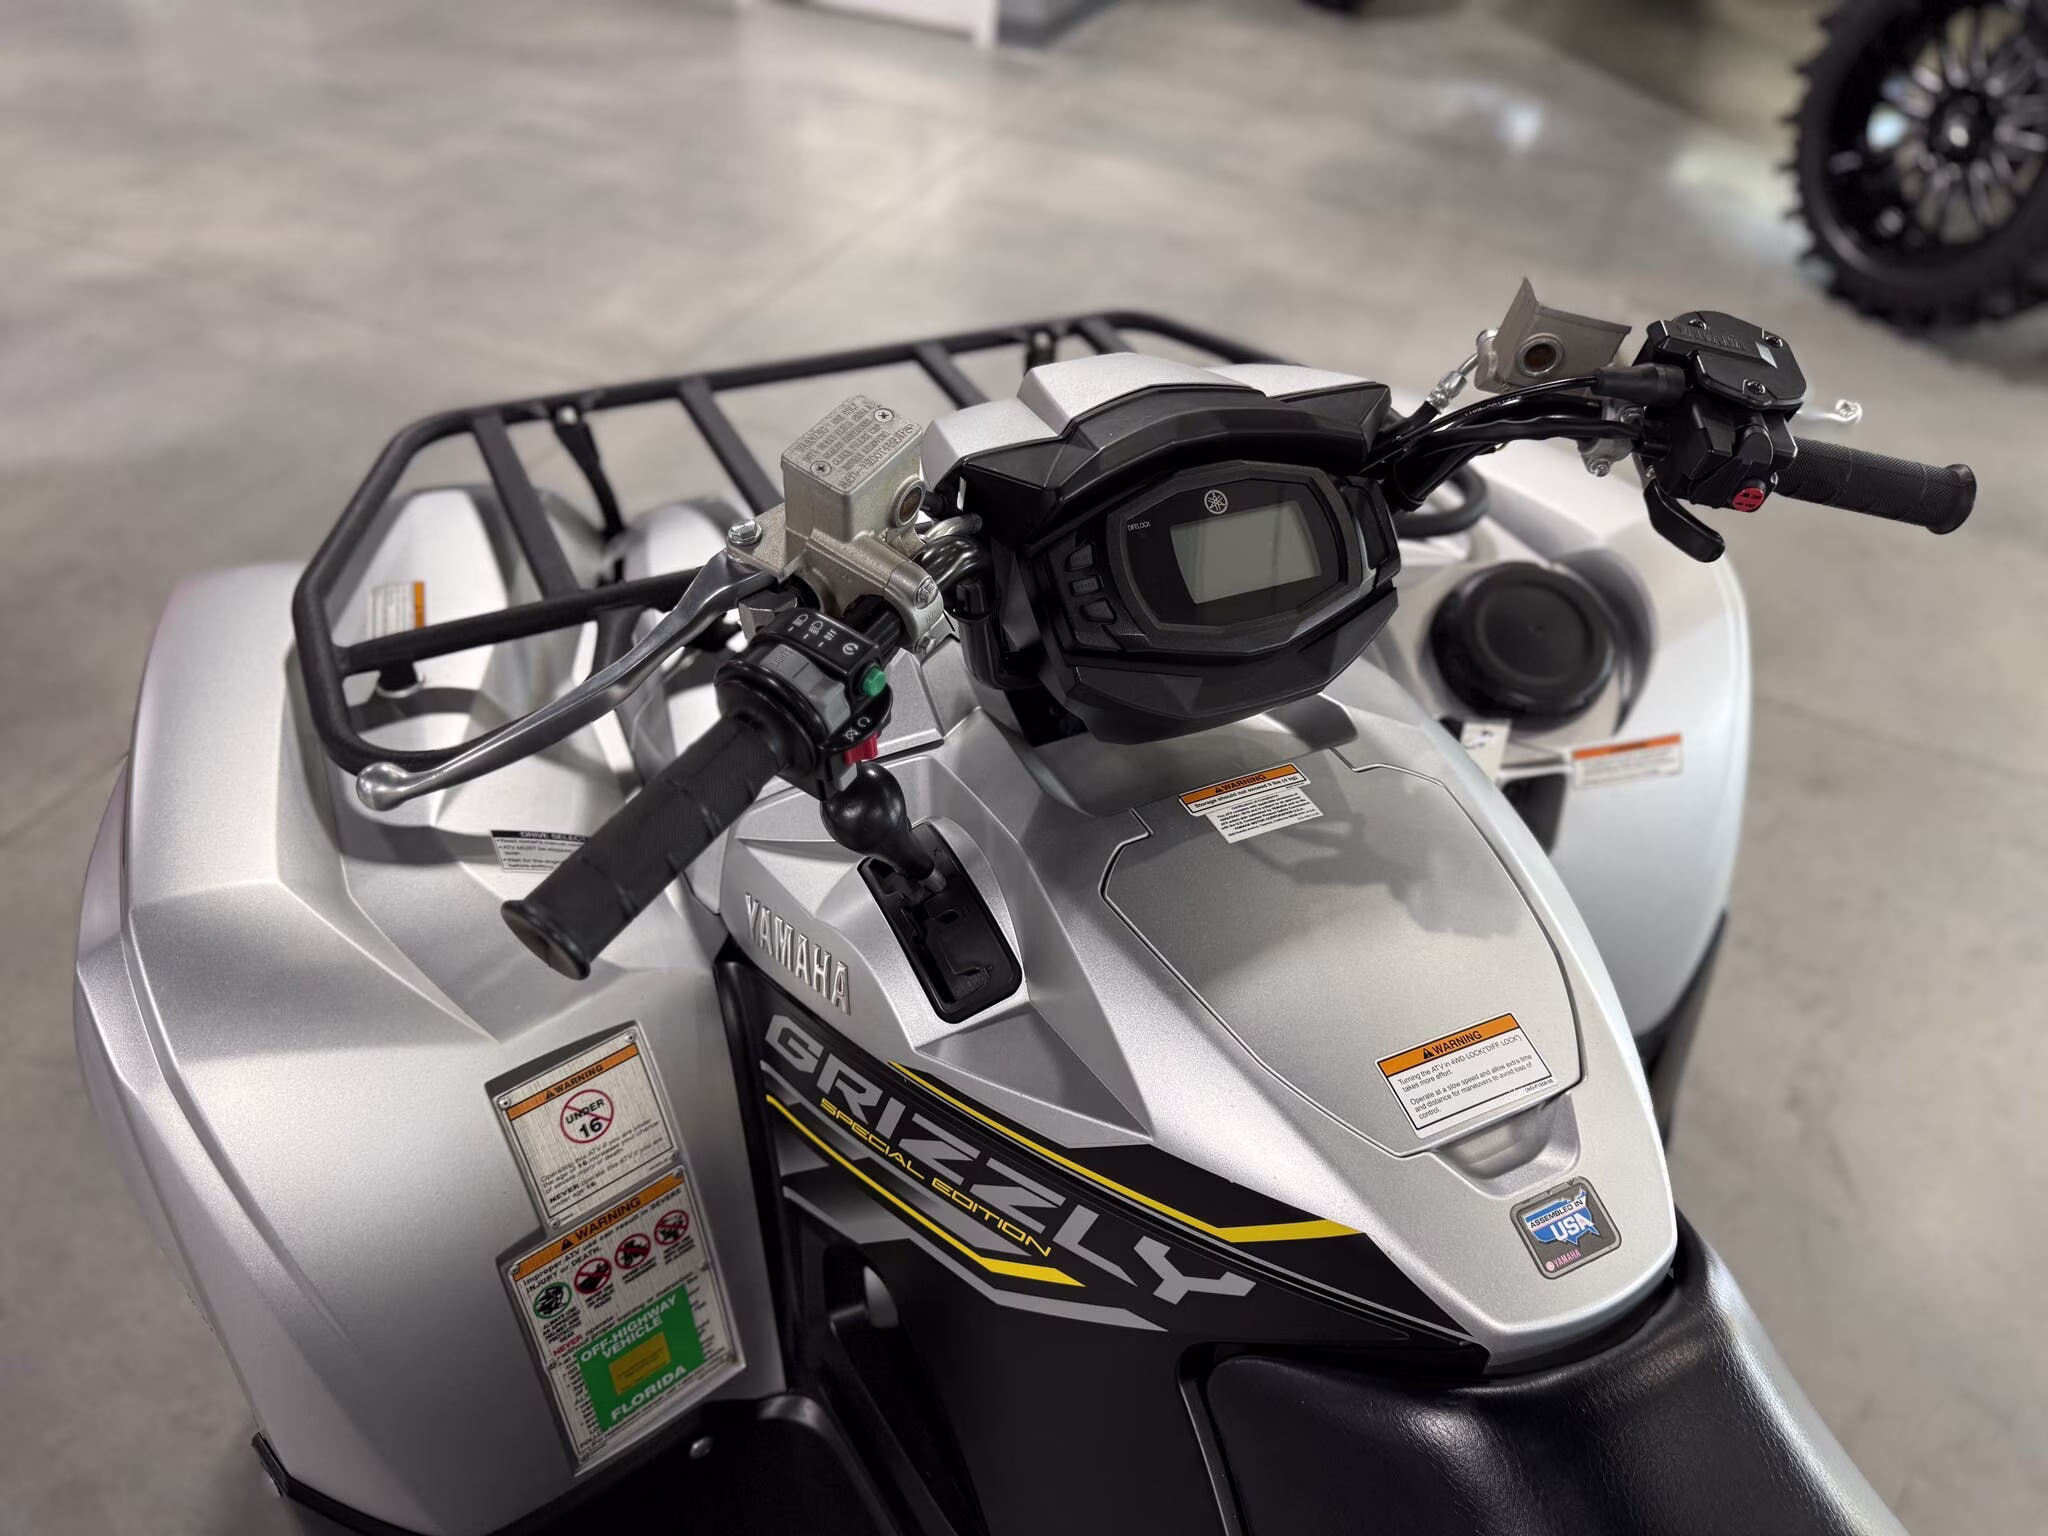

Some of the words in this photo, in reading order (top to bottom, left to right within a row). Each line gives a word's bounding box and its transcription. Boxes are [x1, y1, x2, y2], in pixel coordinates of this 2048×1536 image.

[823, 628, 838, 641] OFF
[1221, 774, 1266, 790] WARNING
[1217, 793, 1237, 801] should
[743, 892, 853, 1015] YAMAHA
[1432, 1031, 1482, 1054] WARNING
[554, 1064, 603, 1093] WARNING
[1398, 1073, 1421, 1085] Turning
[1431, 1063, 1444, 1072] ATV
[1402, 1083, 1420, 1092] takes
[1419, 1076, 1435, 1086] more
[1436, 1069, 1453, 1079] effort.
[1410, 1092, 1435, 1105] Operate
[1447, 1082, 1461, 1091] slow
[1461, 1074, 1479, 1085] speed
[1479, 1069, 1491, 1078] and
[1491, 1065, 1506, 1073] allow
[1506, 1059, 1520, 1068] extra
[1414, 1103, 1427, 1112] and
[1426, 1094, 1452, 1108] distance
[1461, 1078, 1492, 1093] maneuvers
[1499, 1068, 1515, 1078] avoid
[566, 1099, 604, 1124] UNDER
[1418, 1107, 1440, 1120] control.
[580, 1116, 602, 1138] 16
[588, 1147, 601, 1156] ATV
[764, 1014, 1257, 1305] GRIZZLY
[556, 1172, 568, 1182] age
[820, 1098, 925, 1180] SPECIAL
[931, 1177, 1052, 1257] EDITION
[550, 1184, 579, 1203] NEVER
[575, 1198, 640, 1240] WARNING
[1530, 1204, 1573, 1229] ASSEMBLED
[1574, 1199, 1583, 1207] IN
[1549, 1212, 1595, 1241] USA
[523, 1260, 562, 1286] Improper
[565, 1248, 580, 1262] ATV
[583, 1239, 597, 1251] use
[600, 1230, 614, 1240] can
[1553, 1248, 1581, 1267] YAMAHA
[526, 1271, 557, 1294] INJURY
[560, 1265, 568, 1273] or
[553, 1334, 582, 1356] NEVER
[585, 1316, 614, 1336] operate
[581, 1295, 676, 1362] OFF-HIGHWAY
[602, 1316, 662, 1358] VEHICLE
[561, 1337, 590, 1358] without
[612, 1366, 686, 1420] FLORIDA
